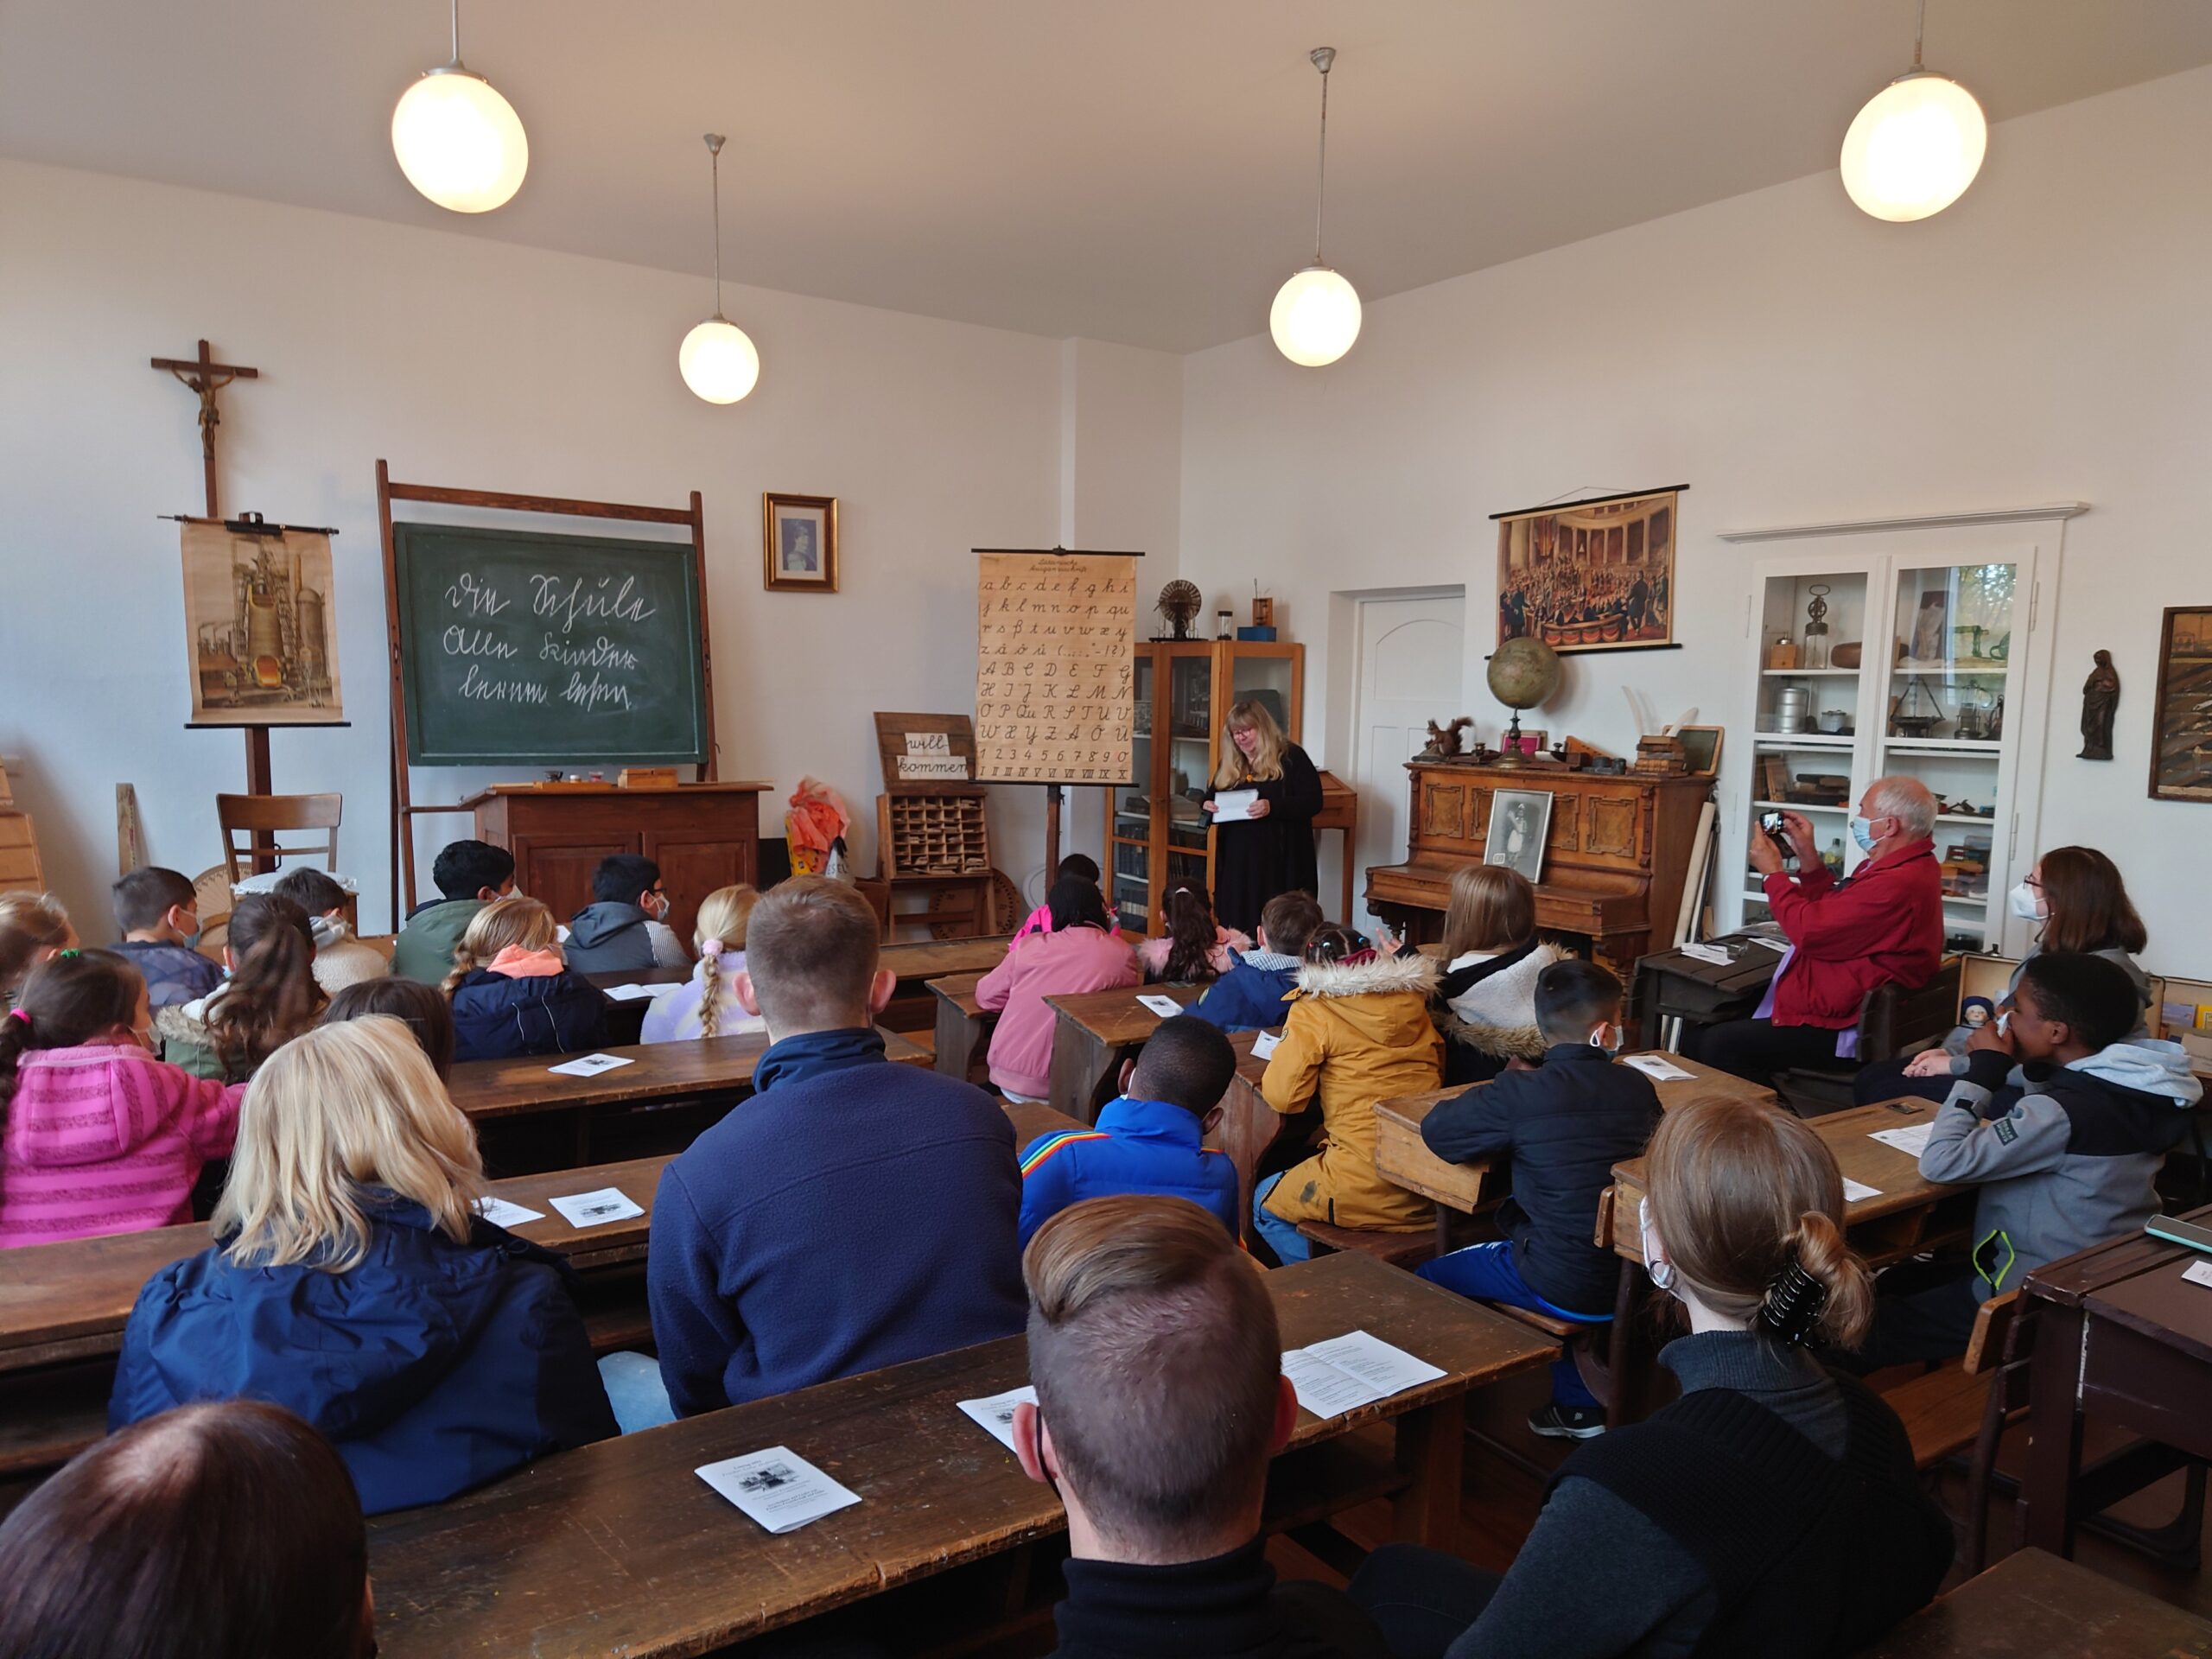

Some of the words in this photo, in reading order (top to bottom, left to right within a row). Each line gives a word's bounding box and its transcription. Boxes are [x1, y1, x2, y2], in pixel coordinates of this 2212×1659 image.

[982, 582, 997, 590] a
[1000, 575, 1012, 590] b
[1033, 577, 1046, 591] d
[1068, 577, 1078, 597] f
[1085, 584, 1096, 598] g
[1103, 578, 1115, 593] h
[1120, 582, 1128, 593] i
[999, 598, 1009, 612] k
[1016, 598, 1027, 612] l
[1033, 604, 1046, 613] m
[1051, 604, 1060, 613] n
[1085, 606, 1098, 619] p
[982, 624, 992, 632] r
[1013, 620, 1023, 639] ß
[1030, 623, 1037, 634] t
[1079, 626, 1095, 635] w
[1116, 628, 1127, 642] y
[981, 645, 989, 654] z
[982, 661, 996, 675] A
[1002, 662, 1014, 676] B
[1023, 663, 1033, 676] C
[1044, 663, 1057, 677] D
[1069, 664, 1078, 677] E
[1093, 664, 1108, 677] F
[1119, 665, 1130, 684] G
[981, 683, 995, 696] H
[1043, 683, 1058, 698] K
[1066, 684, 1080, 698] L
[1086, 685, 1106, 699] M
[1112, 685, 1132, 700] N
[981, 703, 994, 717] O
[999, 704, 1011, 718] P
[1044, 705, 1055, 719] R
[1098, 706, 1109, 721] U
[1117, 707, 1131, 720] V
[982, 725, 1001, 739] W
[1005, 725, 1017, 739] X
[1026, 726, 1038, 745] Y
[1045, 727, 1057, 740] Z
[980, 749, 985, 760] 1
[995, 748, 1002, 760] 2
[1010, 748, 1016, 760] 3
[1025, 750, 1031, 760] 4
[1041, 750, 1048, 760] 5
[1058, 751, 1065, 761] 6
[1075, 751, 1081, 761] 7
[1089, 751, 1098, 762] 8
[1103, 752, 1110, 762] 9
[1118, 752, 1128, 762] 0
[899, 757, 968, 772] kommen
[992, 767, 999, 776] II
[1004, 767, 1013, 776] III
[1019, 767, 1029, 777] IV
[1034, 768, 1041, 777] V
[1049, 768, 1057, 778] VI
[1065, 769, 1075, 778] VII
[1083, 769, 1094, 779] VIII
[1099, 769, 1110, 779] IX
[1118, 770, 1128, 779] X
